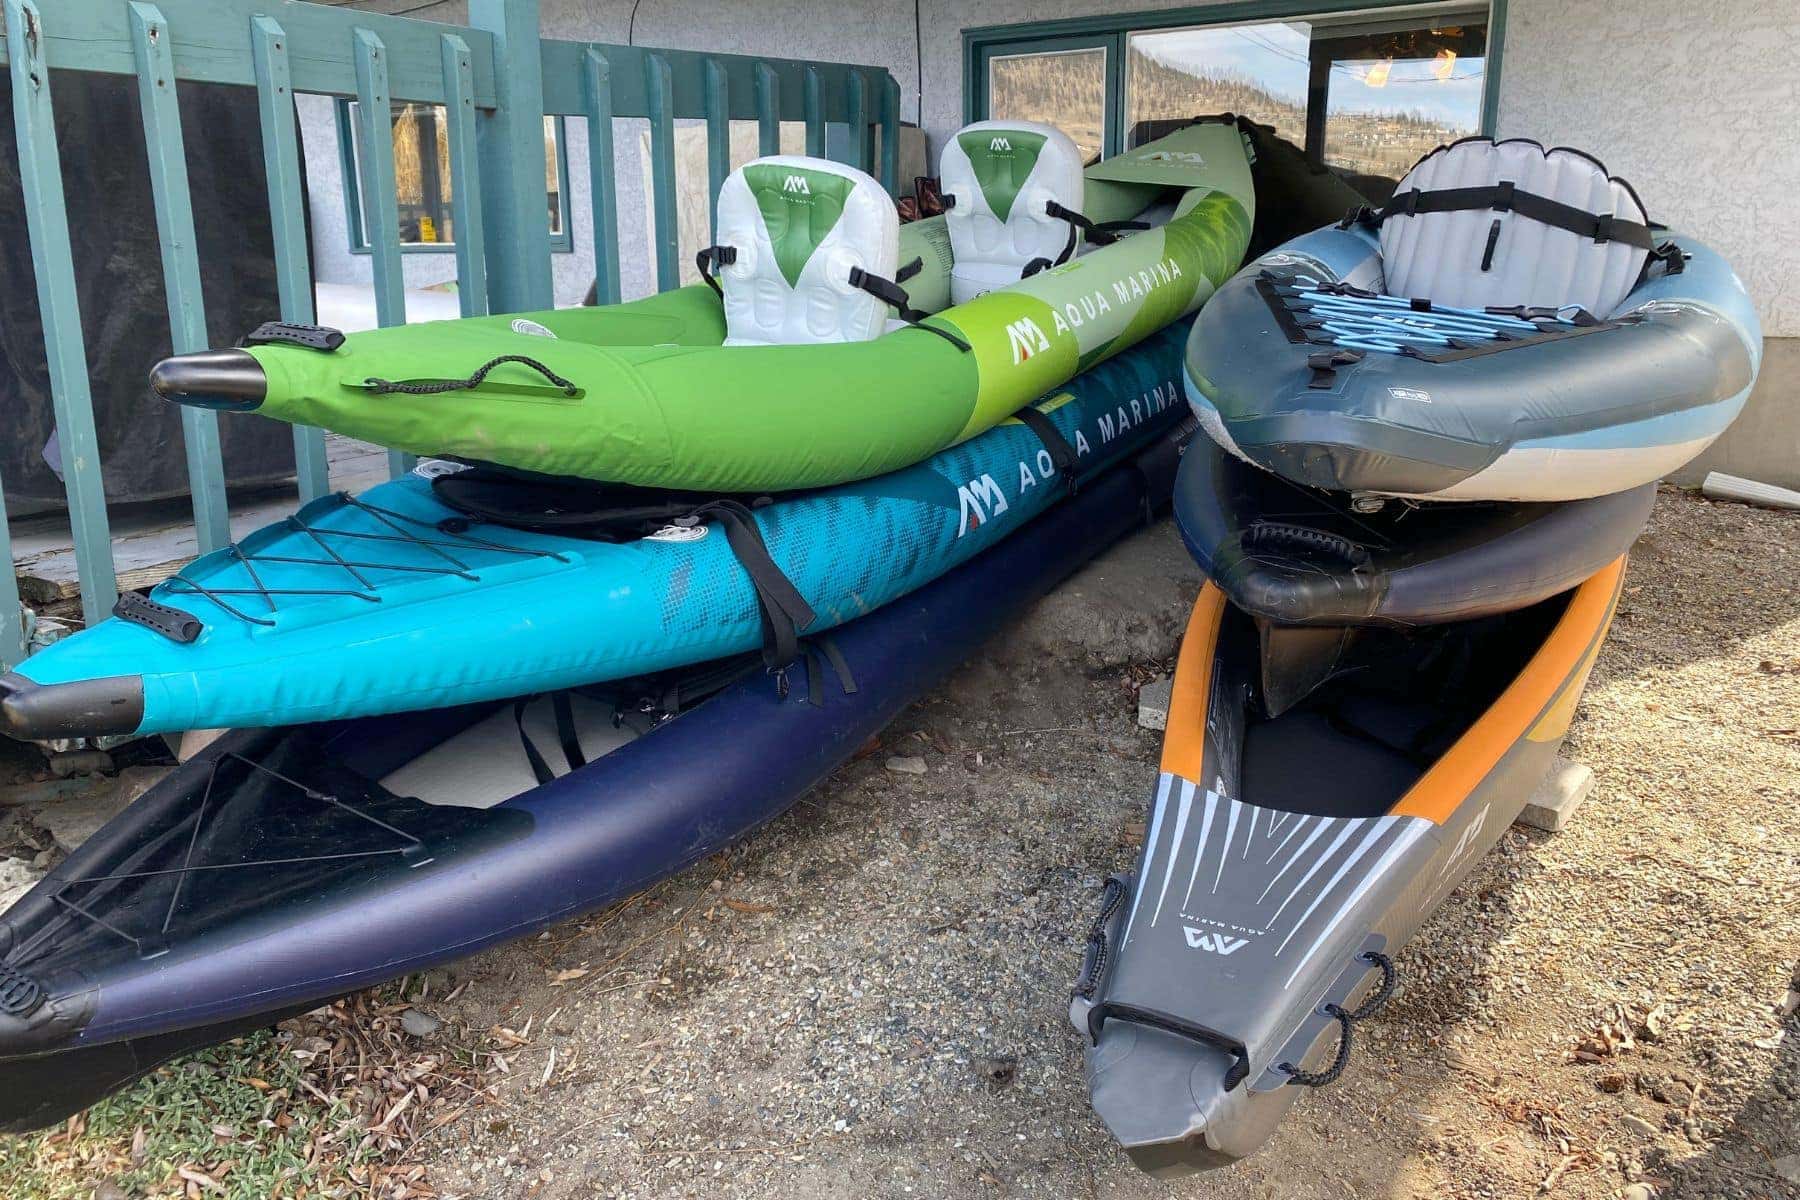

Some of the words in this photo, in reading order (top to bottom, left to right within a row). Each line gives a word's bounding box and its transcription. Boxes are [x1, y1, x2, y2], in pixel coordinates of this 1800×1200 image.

[1052, 291, 1111, 336] AQUA
[1112, 258, 1182, 305] MARINA
[1020, 430, 1090, 494] AQA
[1098, 381, 1179, 443] MARINA
